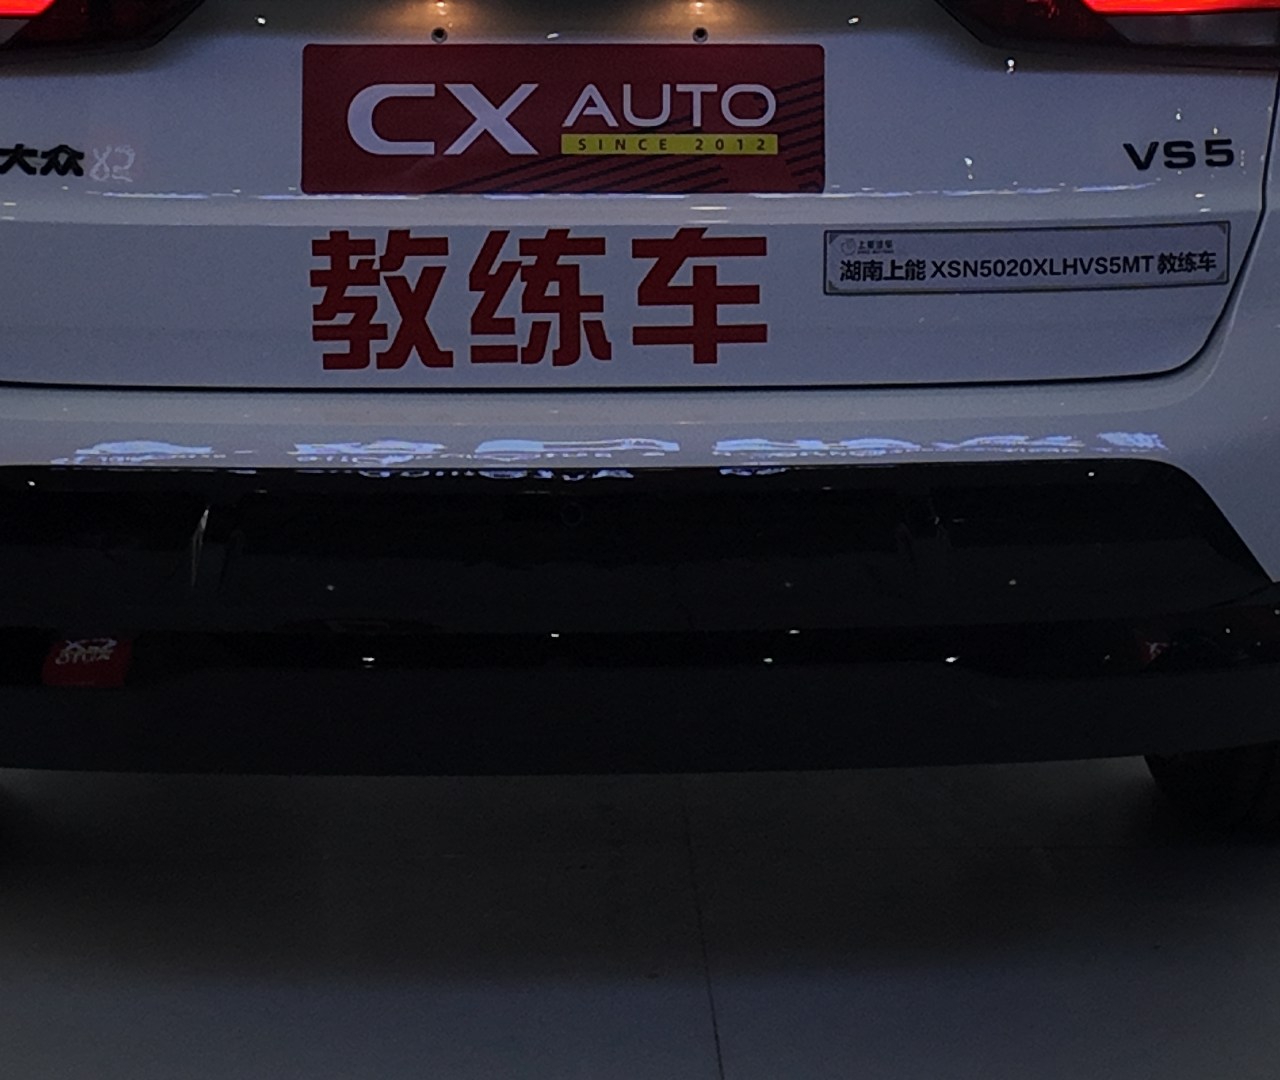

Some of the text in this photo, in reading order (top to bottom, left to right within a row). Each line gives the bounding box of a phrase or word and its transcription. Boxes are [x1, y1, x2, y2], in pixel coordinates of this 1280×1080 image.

[347, 83, 777, 155] CX AUTO
[577, 138, 768, 151] SINCE 2012
[1122, 139, 1237, 170] VS5
[839, 251, 1218, 283] 湖南上能 XSN5020XLHVS5MT 教练车
[309, 227, 769, 371] 教练车
